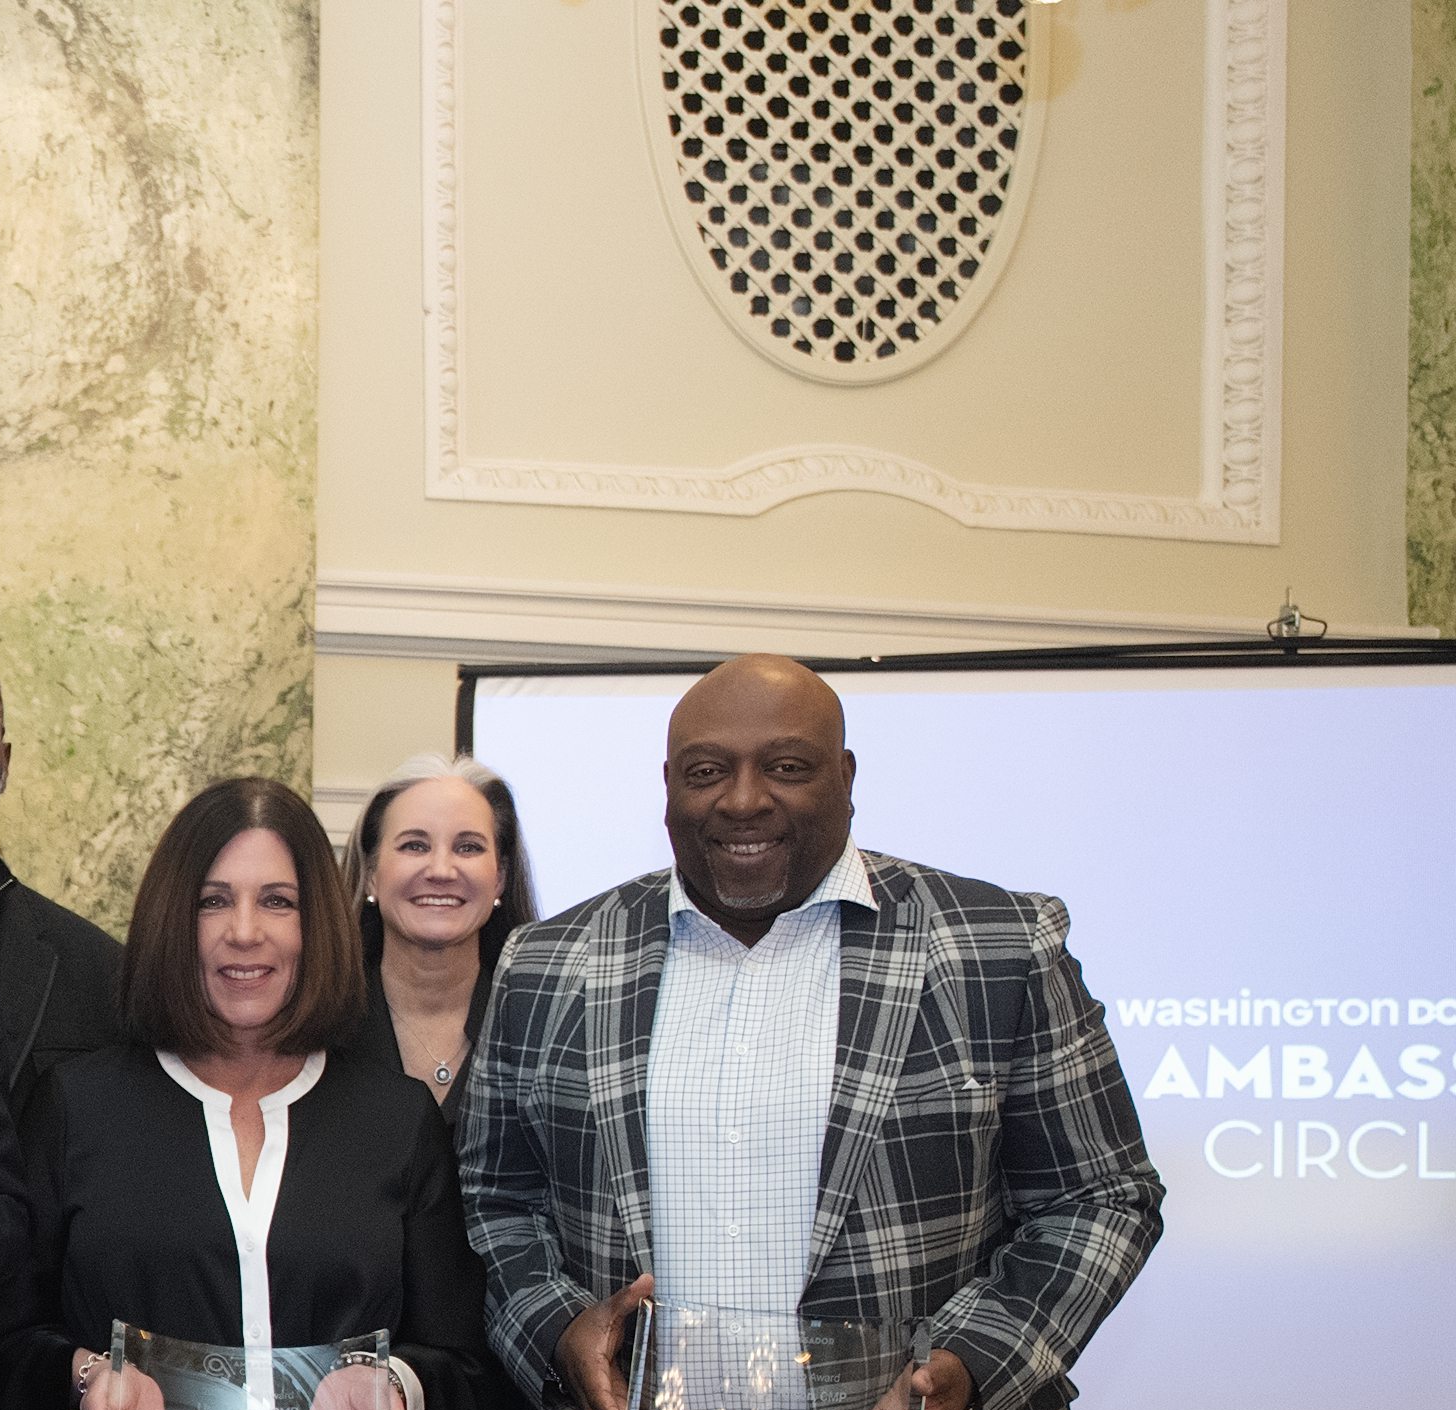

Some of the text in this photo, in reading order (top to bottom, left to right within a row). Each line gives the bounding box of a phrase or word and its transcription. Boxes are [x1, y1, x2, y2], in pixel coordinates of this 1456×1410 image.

[1143, 1044, 1456, 1100] AMBAS
[811, 1373, 842, 1384] Award
[820, 1391, 848, 1403] CMP
